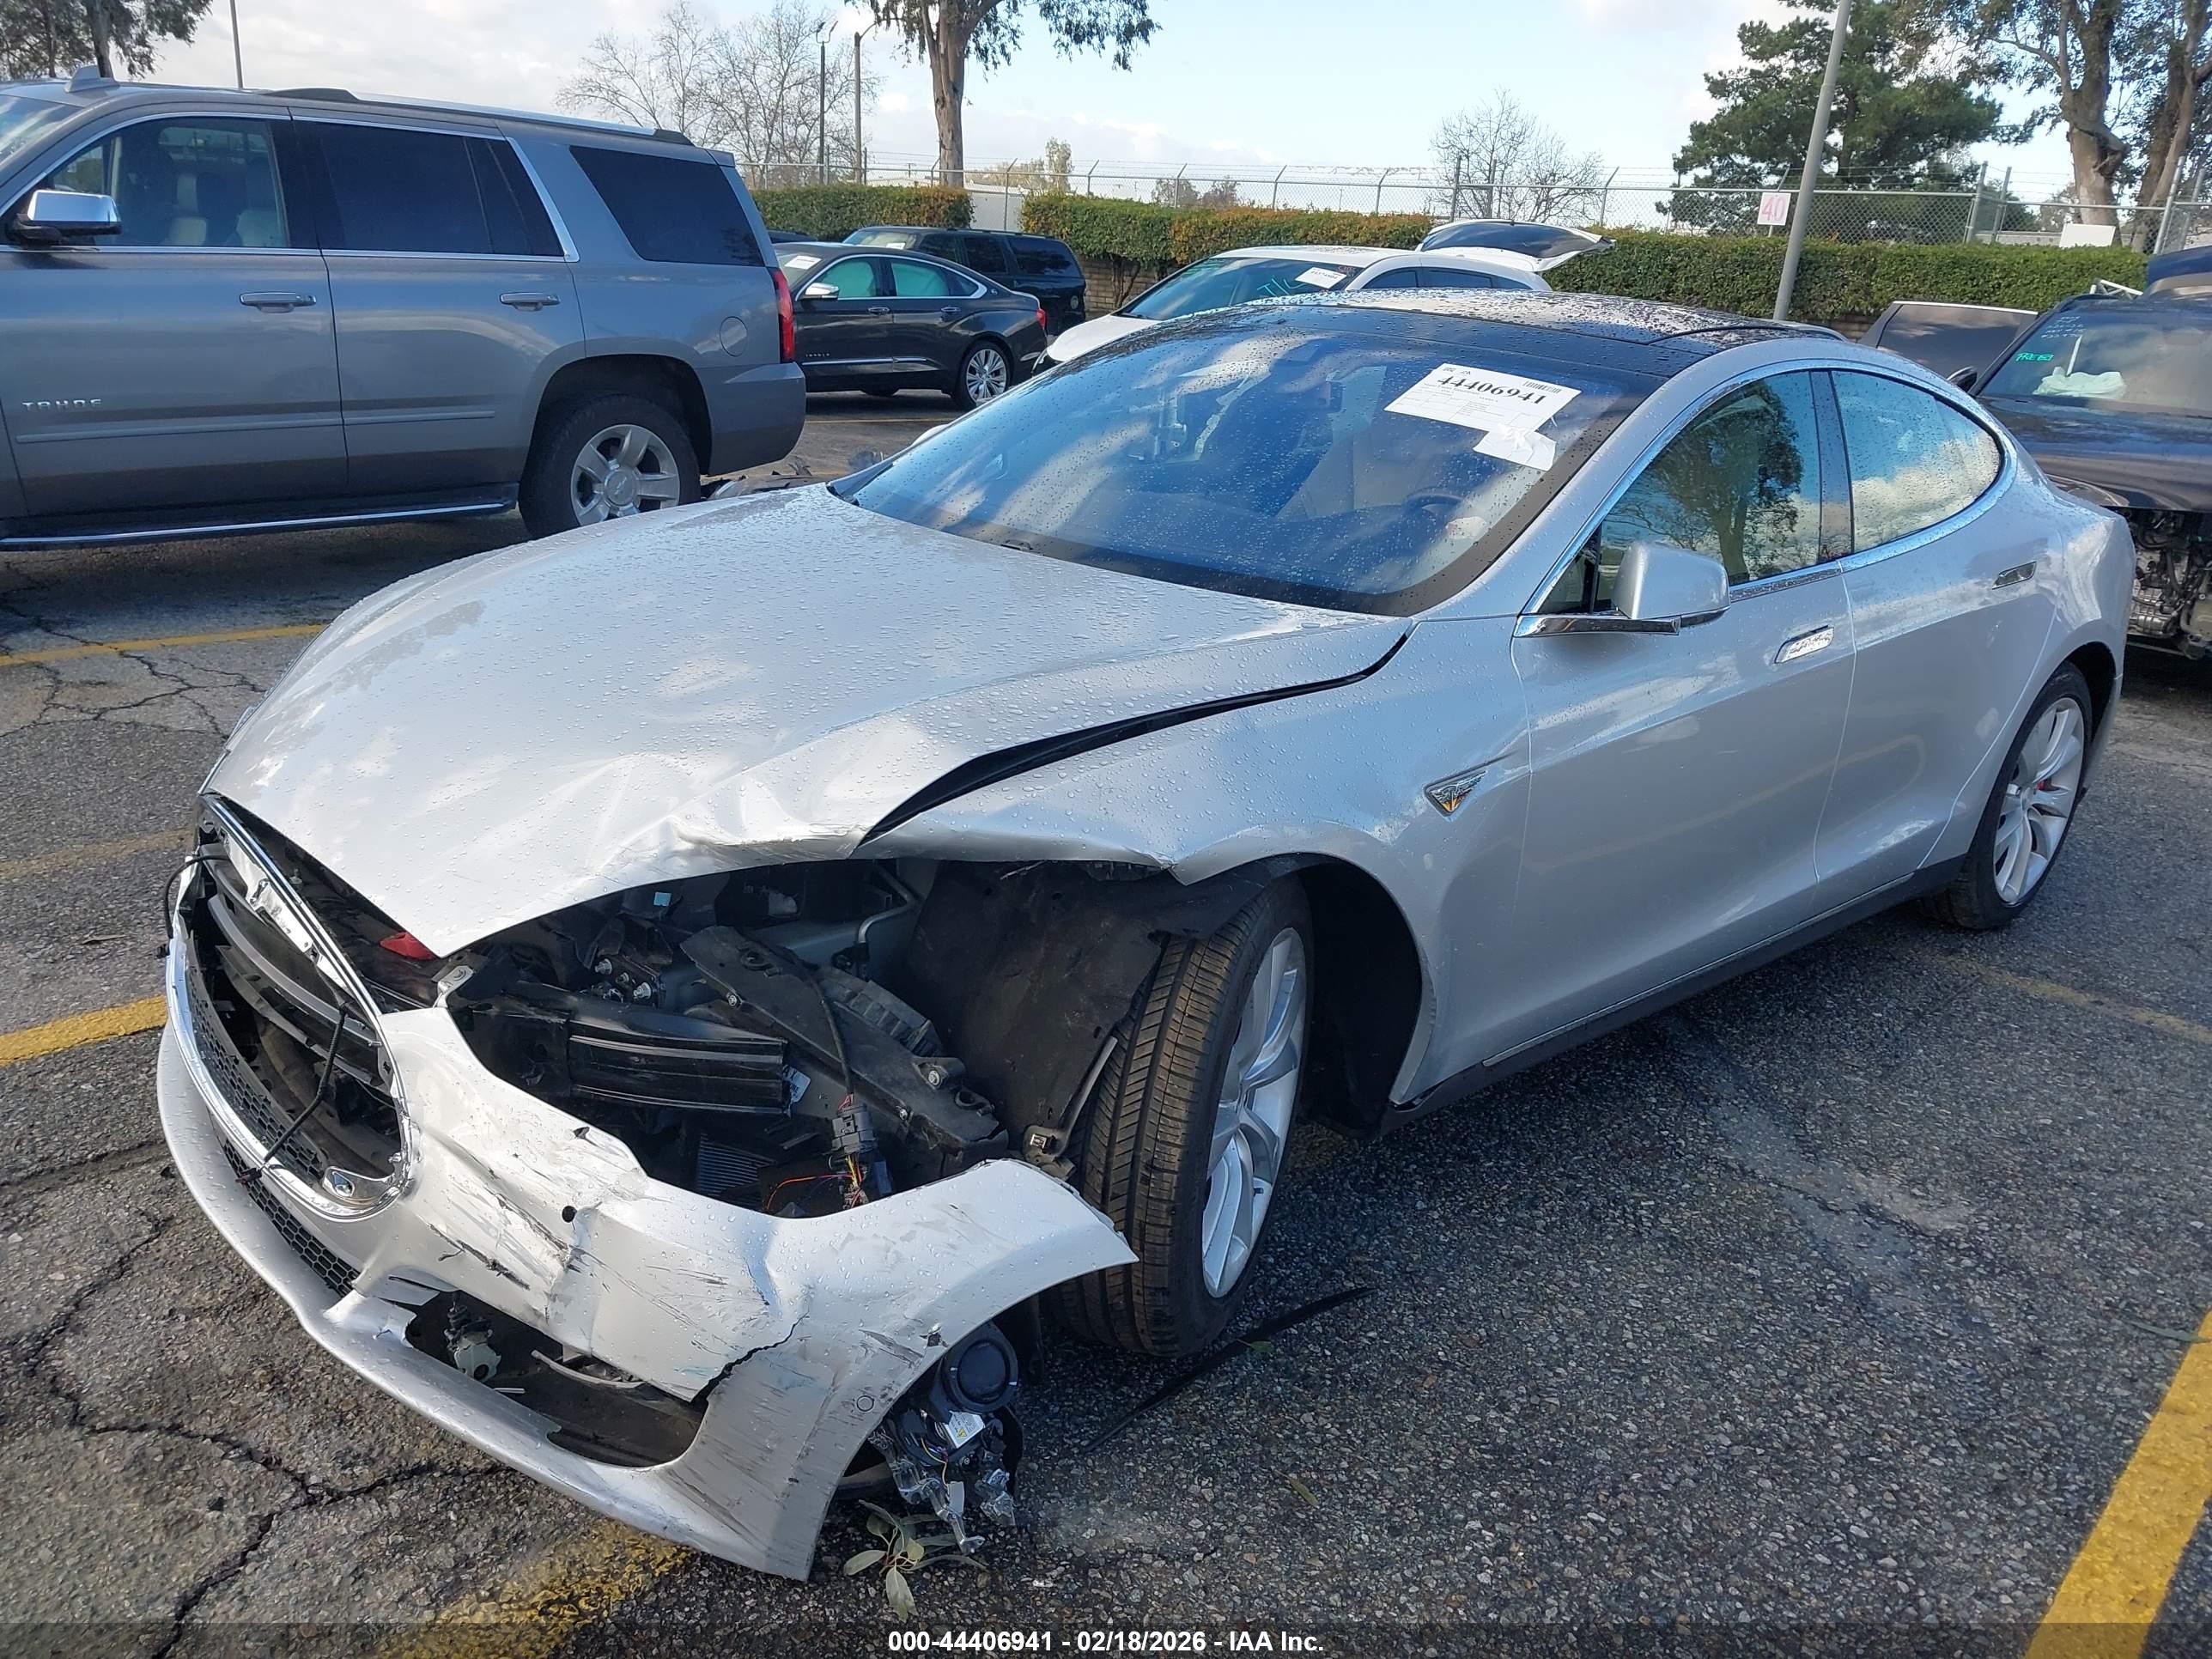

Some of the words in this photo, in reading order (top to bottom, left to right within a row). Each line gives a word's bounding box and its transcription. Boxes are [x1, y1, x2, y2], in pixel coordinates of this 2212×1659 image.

[1762, 197, 1786, 221] 40
[1437, 375, 1547, 404] 44406941
[21, 398, 102, 411] TAHOE
